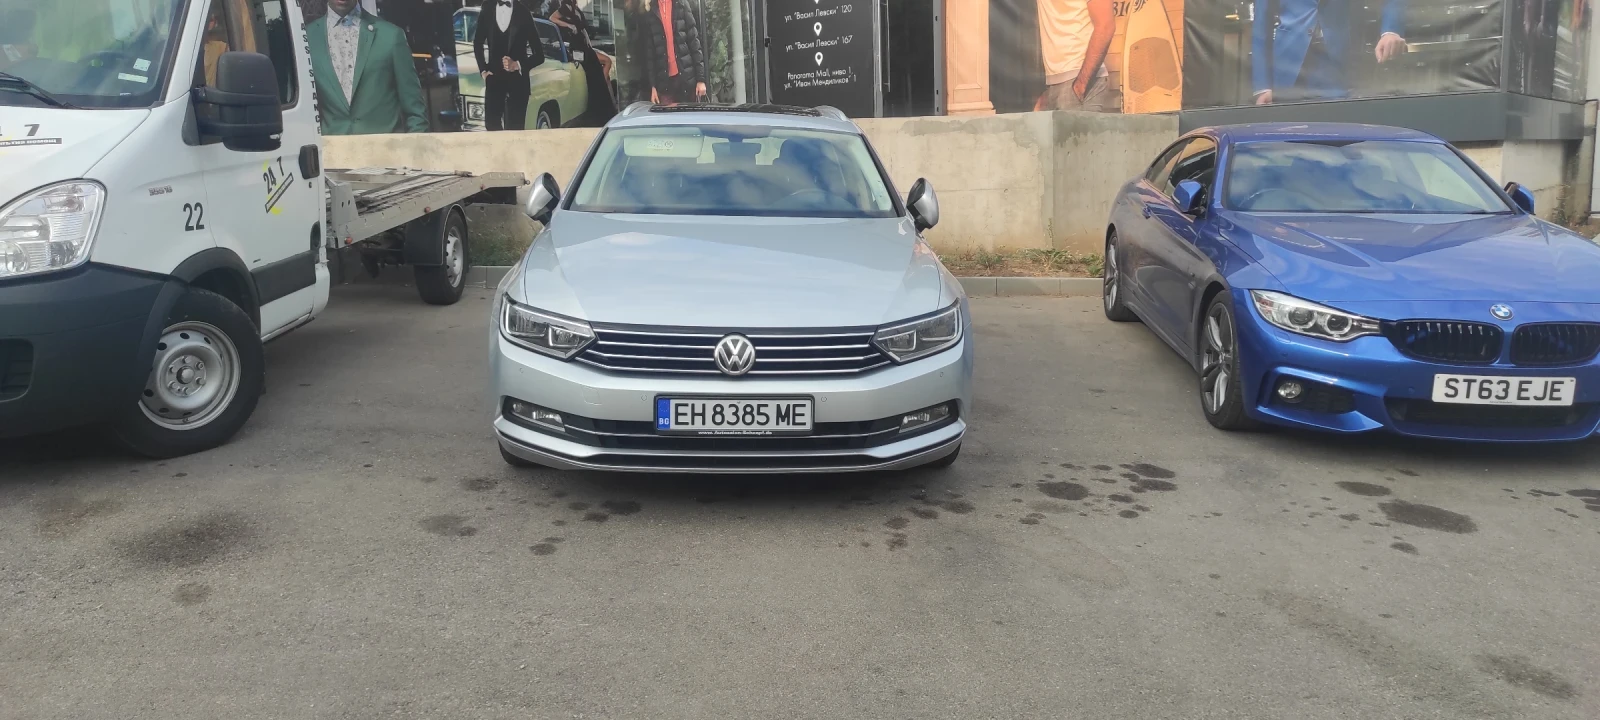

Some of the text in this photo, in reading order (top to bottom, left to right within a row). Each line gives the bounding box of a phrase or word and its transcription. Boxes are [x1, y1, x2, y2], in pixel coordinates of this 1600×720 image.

[841, 4, 853, 13] 120
[841, 34, 853, 44] 167
[301, 23, 322, 134] ASSISTANCE
[787, 72, 815, 80] Panorama
[24, 123, 40, 137] 7
[183, 202, 205, 232] 22
[1444, 377, 1565, 401] ST63 EJE
[658, 417, 670, 426] BG
[674, 403, 807, 426] EH 8385 ME
